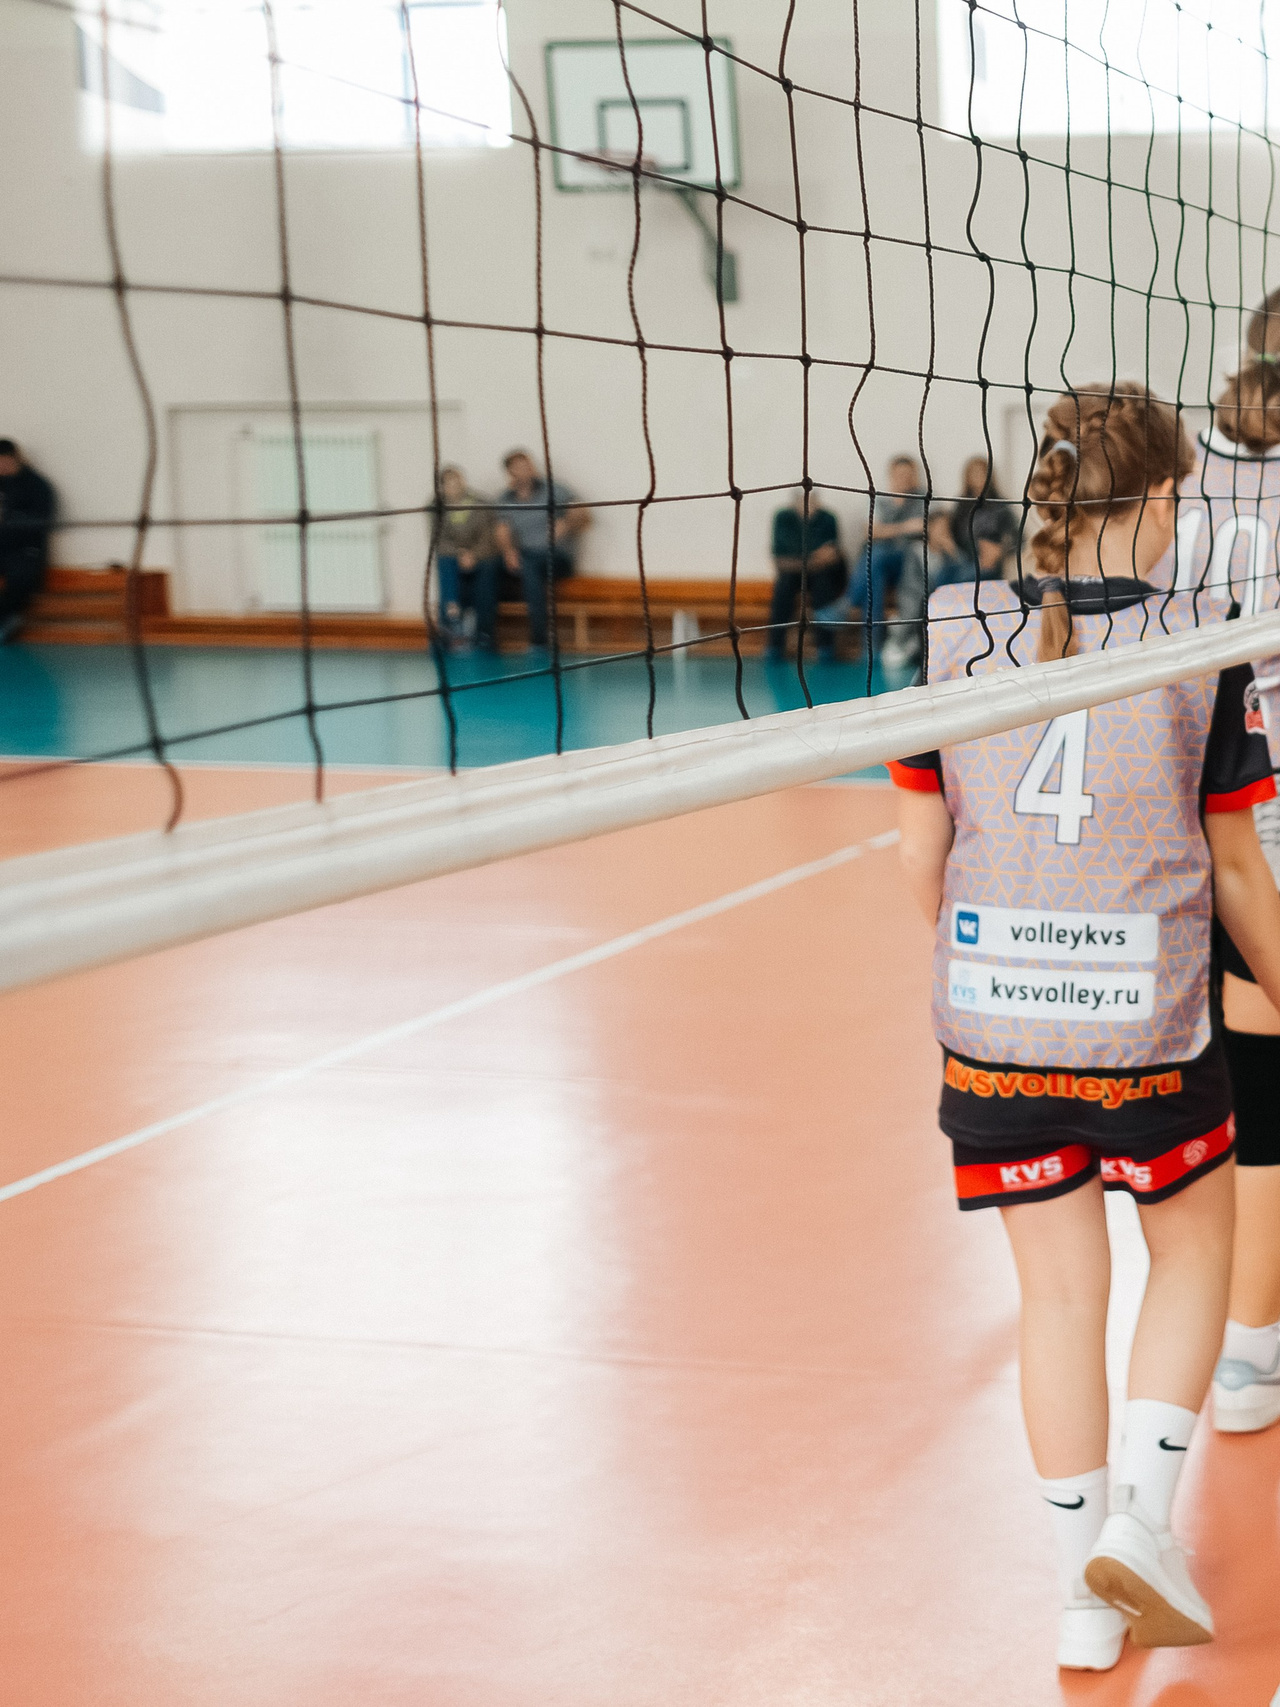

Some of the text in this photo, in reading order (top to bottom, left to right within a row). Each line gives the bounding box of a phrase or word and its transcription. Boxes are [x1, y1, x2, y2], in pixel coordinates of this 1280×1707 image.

[1014, 708, 1095, 845] 4
[1010, 921, 1126, 949] volleykvs
[991, 976, 1139, 1010] kvsvolley.ru
[945, 1056, 1183, 1109] kvsvolley.ru
[1000, 1156, 1064, 1184] KVS
